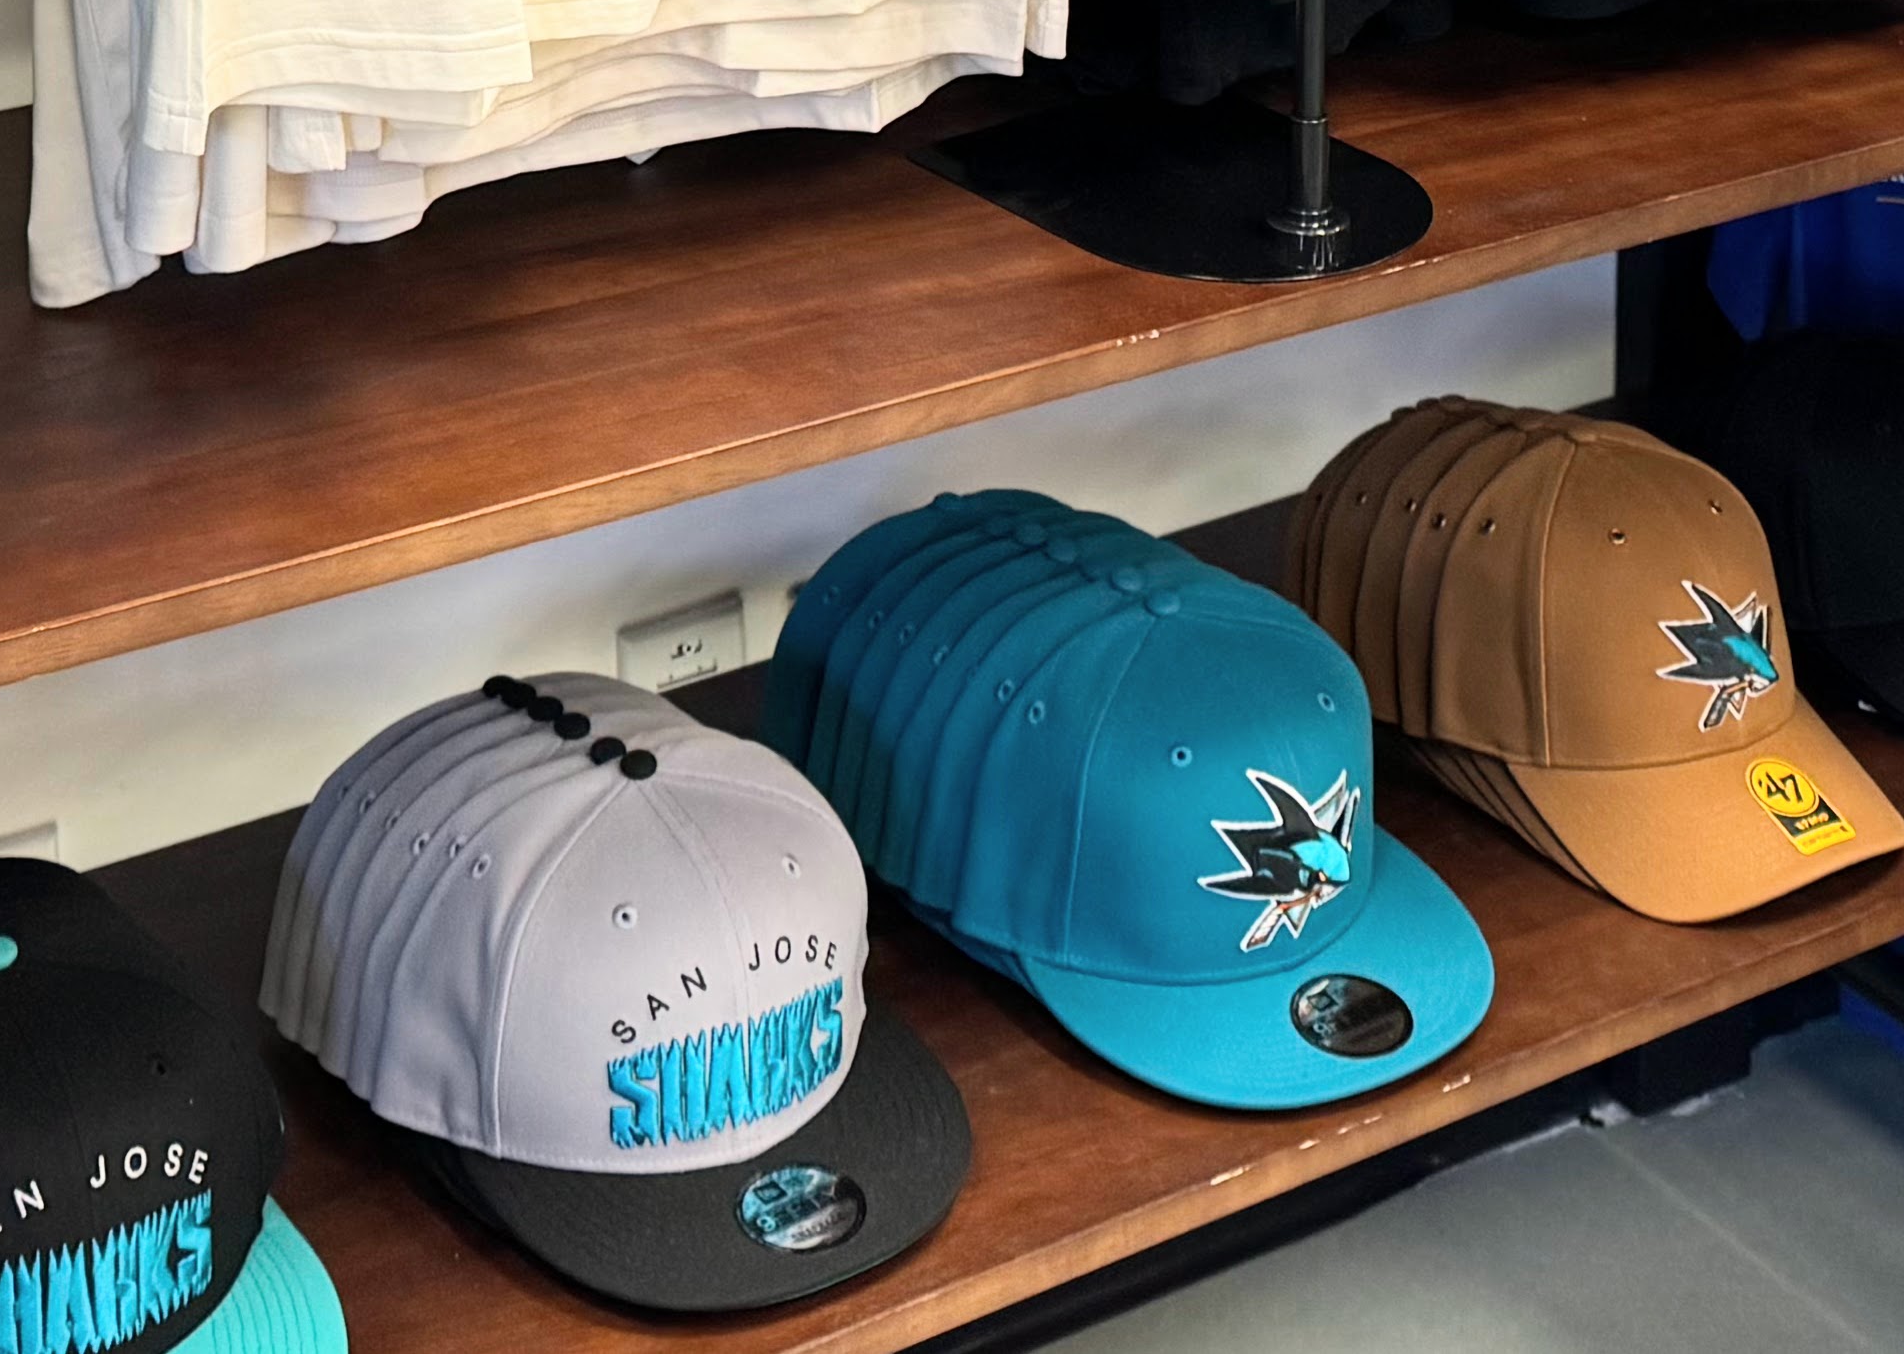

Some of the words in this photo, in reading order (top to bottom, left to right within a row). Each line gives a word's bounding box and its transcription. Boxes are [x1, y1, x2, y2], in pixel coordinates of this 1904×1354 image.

[611, 966, 708, 1045] SAN
[748, 934, 838, 972] JOSE
[606, 976, 844, 1150] SHARKS
[88, 1142, 209, 1189] JOSE
